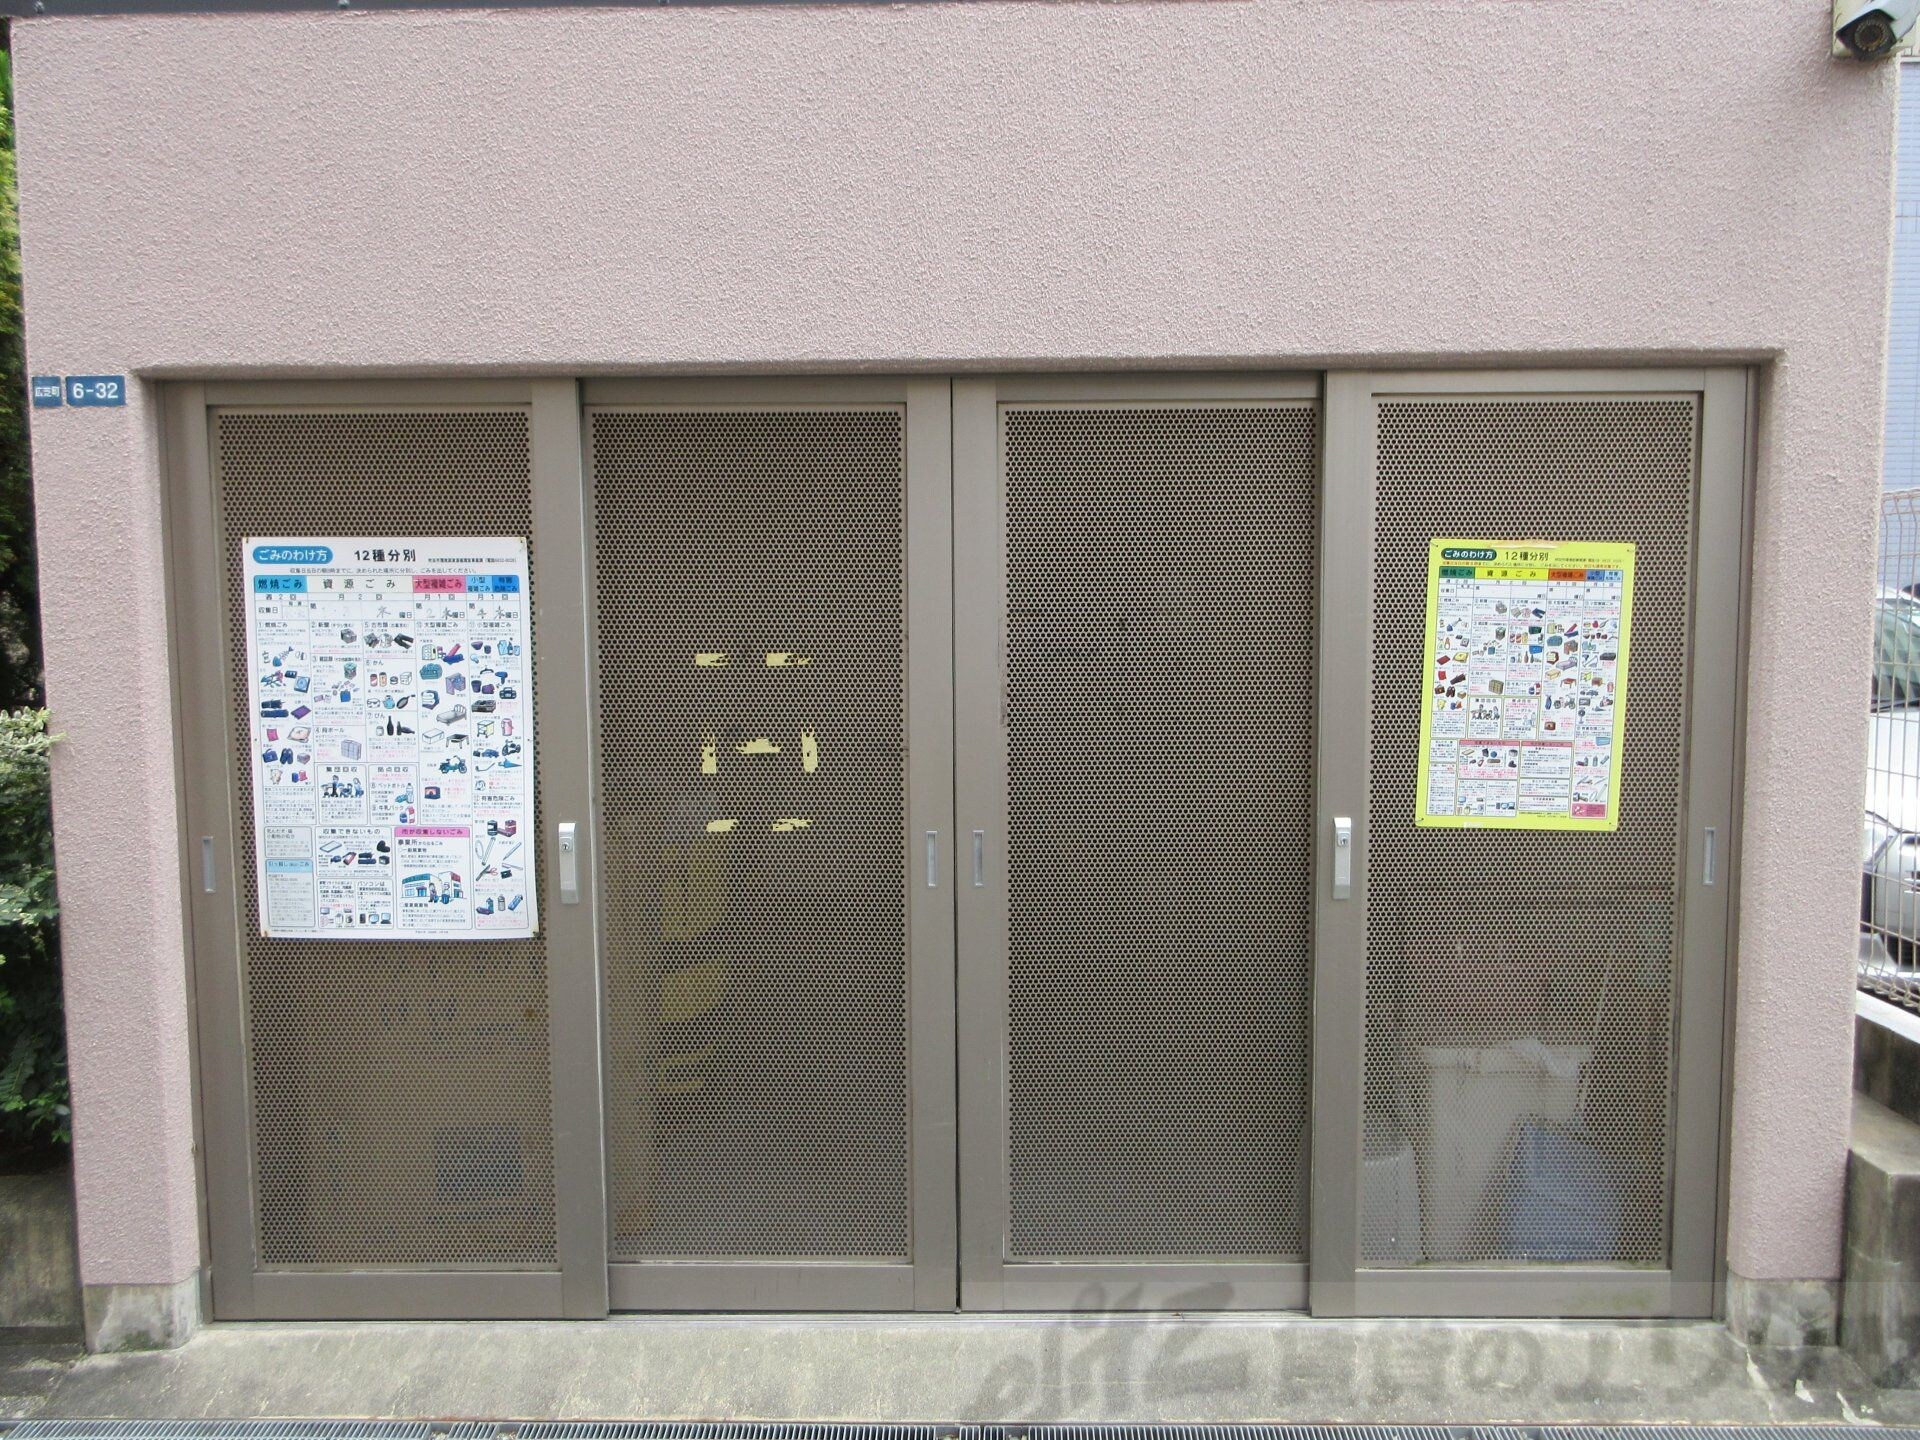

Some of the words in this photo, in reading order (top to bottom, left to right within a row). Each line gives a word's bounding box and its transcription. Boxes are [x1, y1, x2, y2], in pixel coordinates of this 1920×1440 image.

[73, 383, 118, 399] 6-32
[258, 549, 328, 562] ごみのわけ方
[354, 549, 416, 562] 12種分別
[1444, 550, 1494, 560] ごみのわけ方
[1505, 551, 1549, 562] 12種分別
[258, 578, 303, 590] 燃焼ごみ
[415, 578, 463, 590] 大型複雑ごみ
[471, 576, 486, 584] 小型
